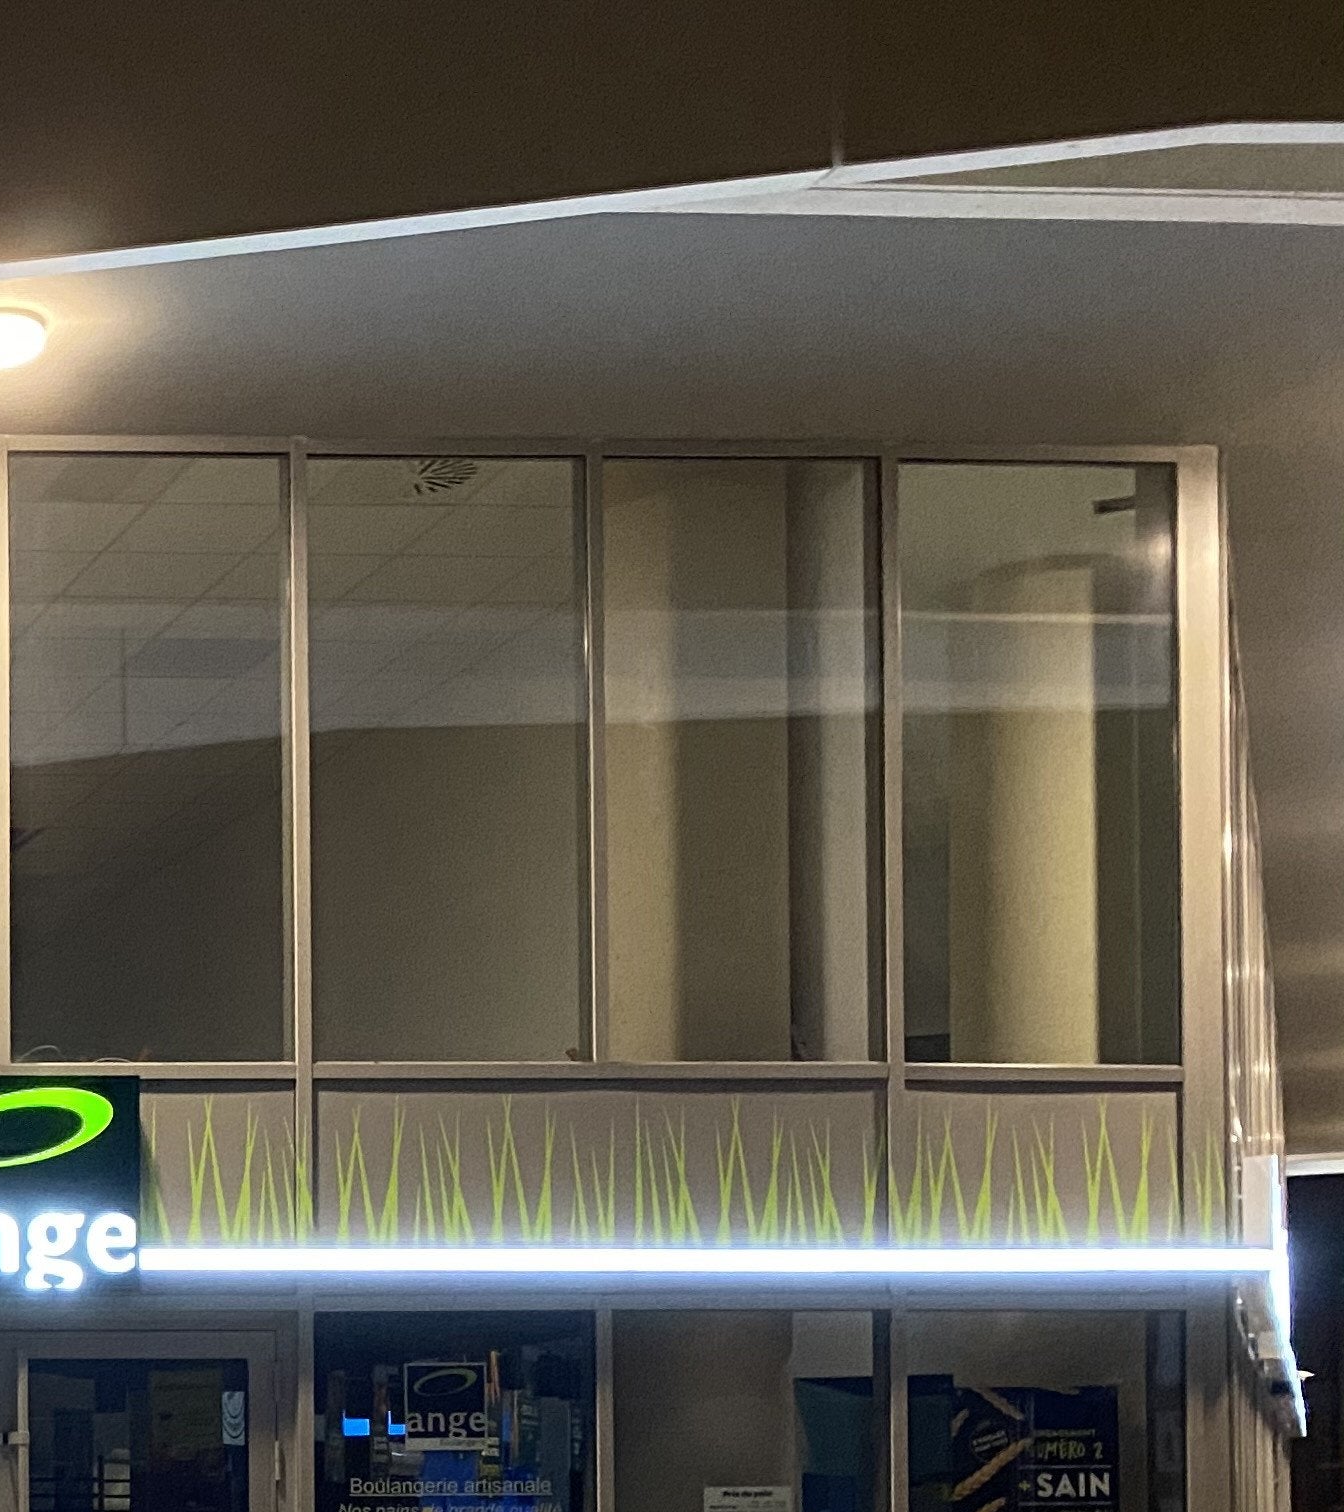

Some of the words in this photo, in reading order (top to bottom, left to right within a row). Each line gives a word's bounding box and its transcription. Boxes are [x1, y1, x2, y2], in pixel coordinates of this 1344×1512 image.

[407, 1411, 487, 1440] ange
[349, 1477, 458, 1494] Boulangerie
[464, 1477, 552, 1493] artisanale
[1036, 1472, 1111, 1498] SAIN
